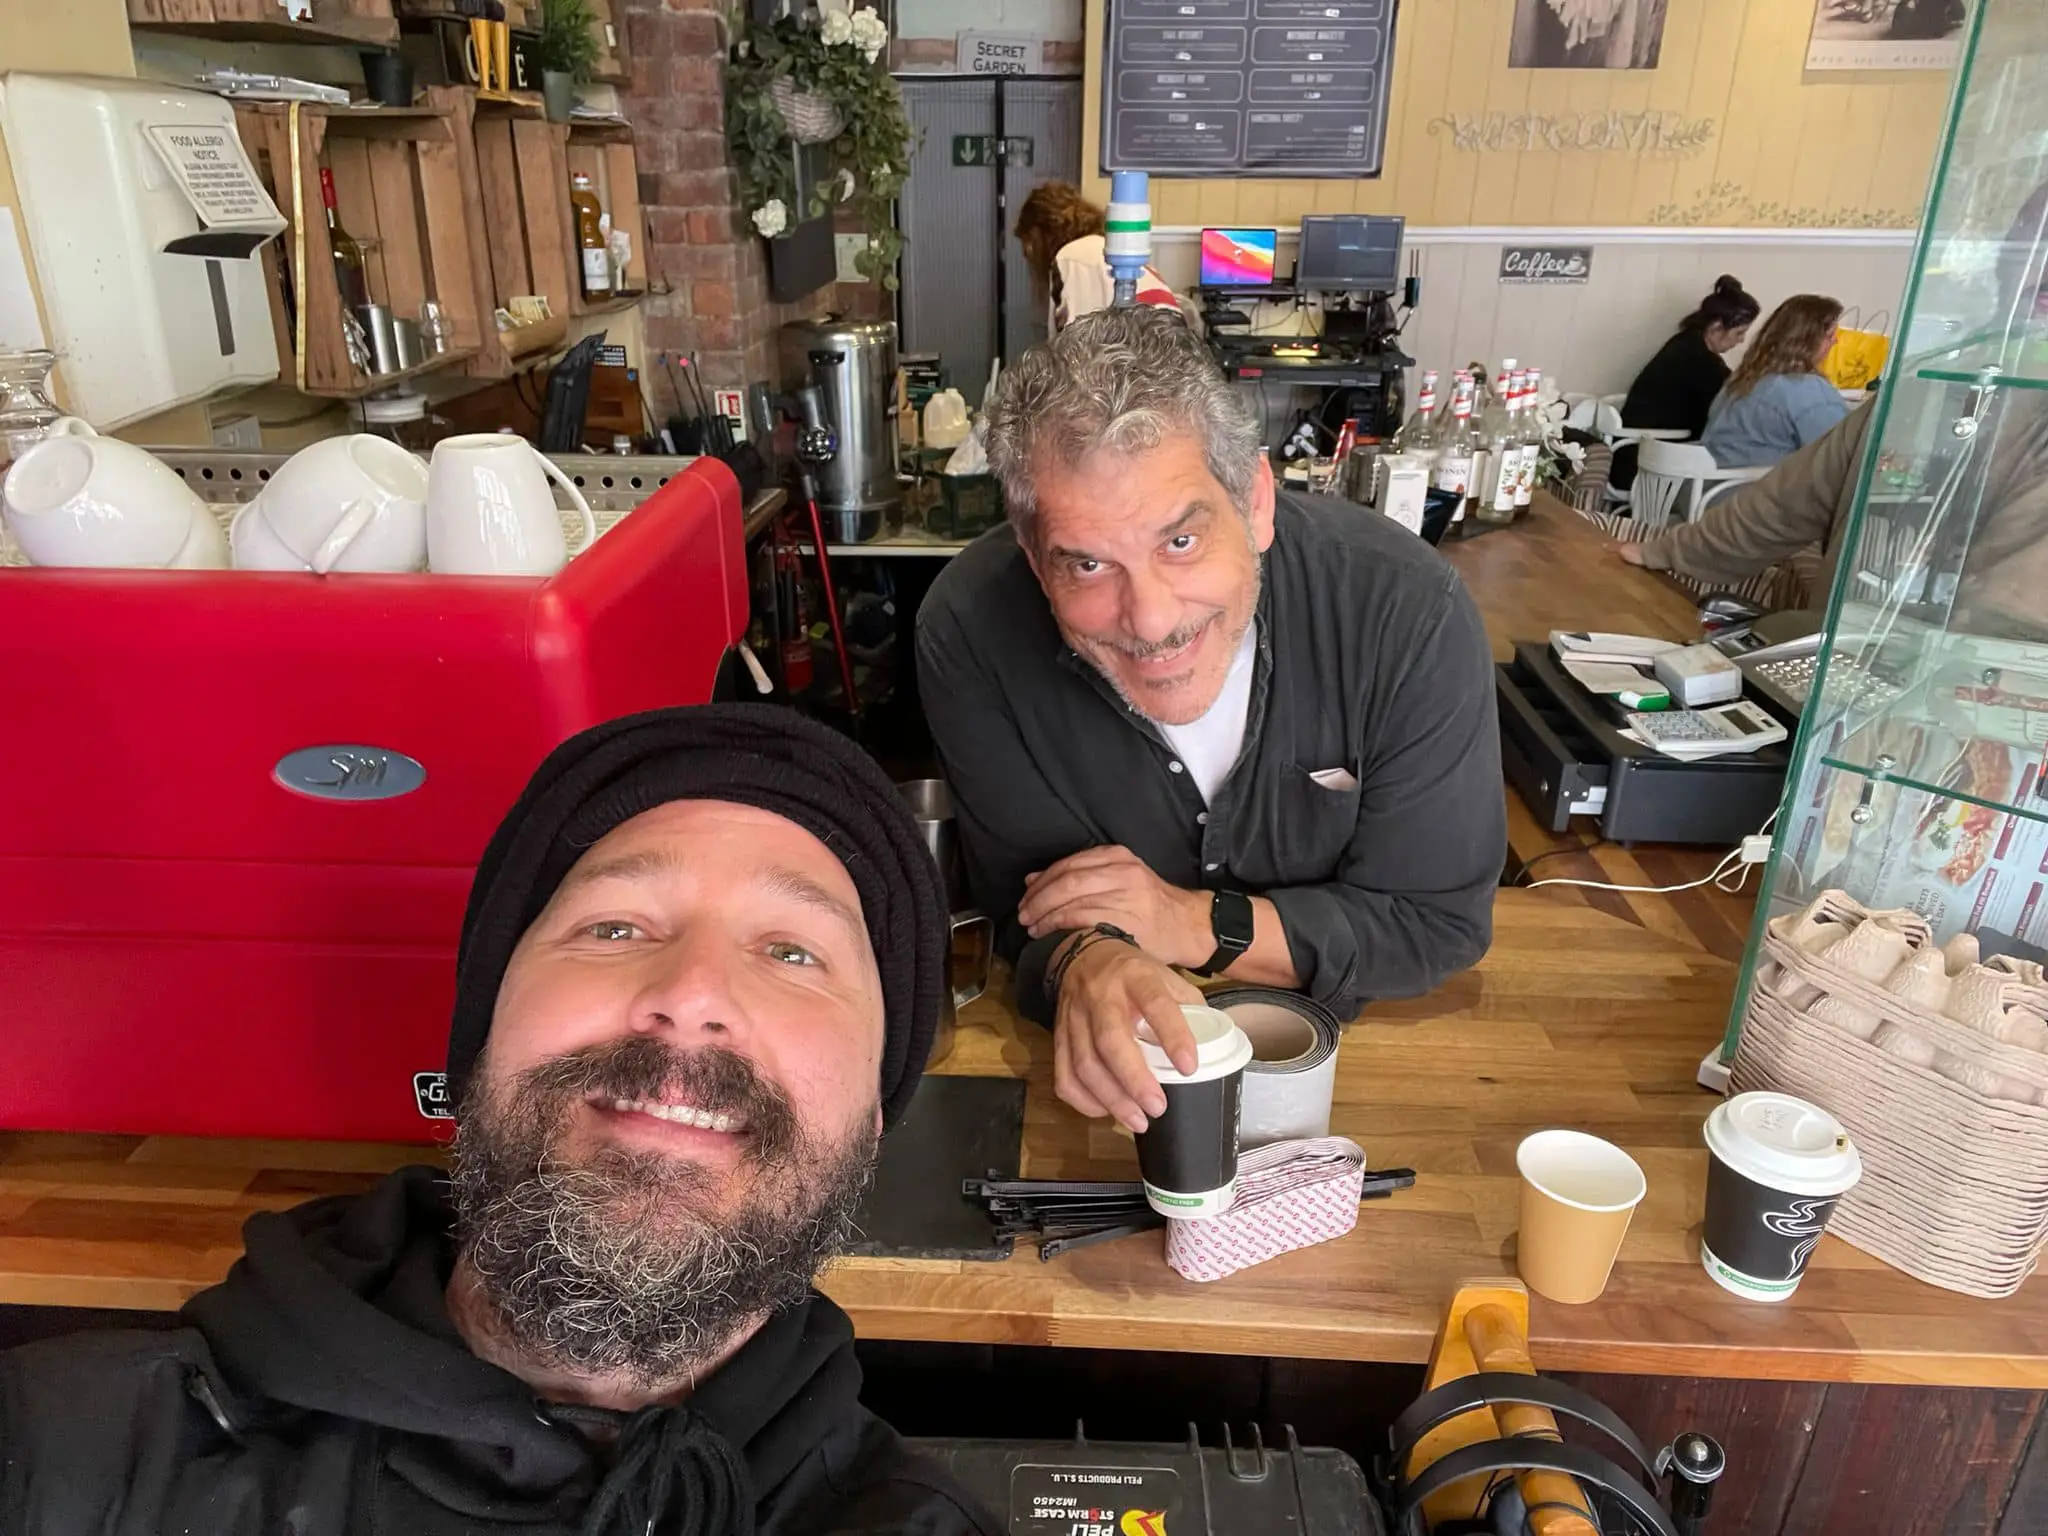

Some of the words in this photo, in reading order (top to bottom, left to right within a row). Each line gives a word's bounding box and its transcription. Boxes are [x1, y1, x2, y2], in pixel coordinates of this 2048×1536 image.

[977, 41, 1026, 59] SECRET
[972, 58, 1026, 75] GARDEN
[170, 135, 193, 147] FOOD
[193, 135, 225, 147] ALLERGY
[192, 150, 221, 160] NOTICE
[1504, 251, 1566, 278] Coffee
[1051, 1473, 1077, 1483] S.L.U.
[1078, 1474, 1122, 1484] PRODUCTS
[1124, 1475, 1143, 1485] PELI
